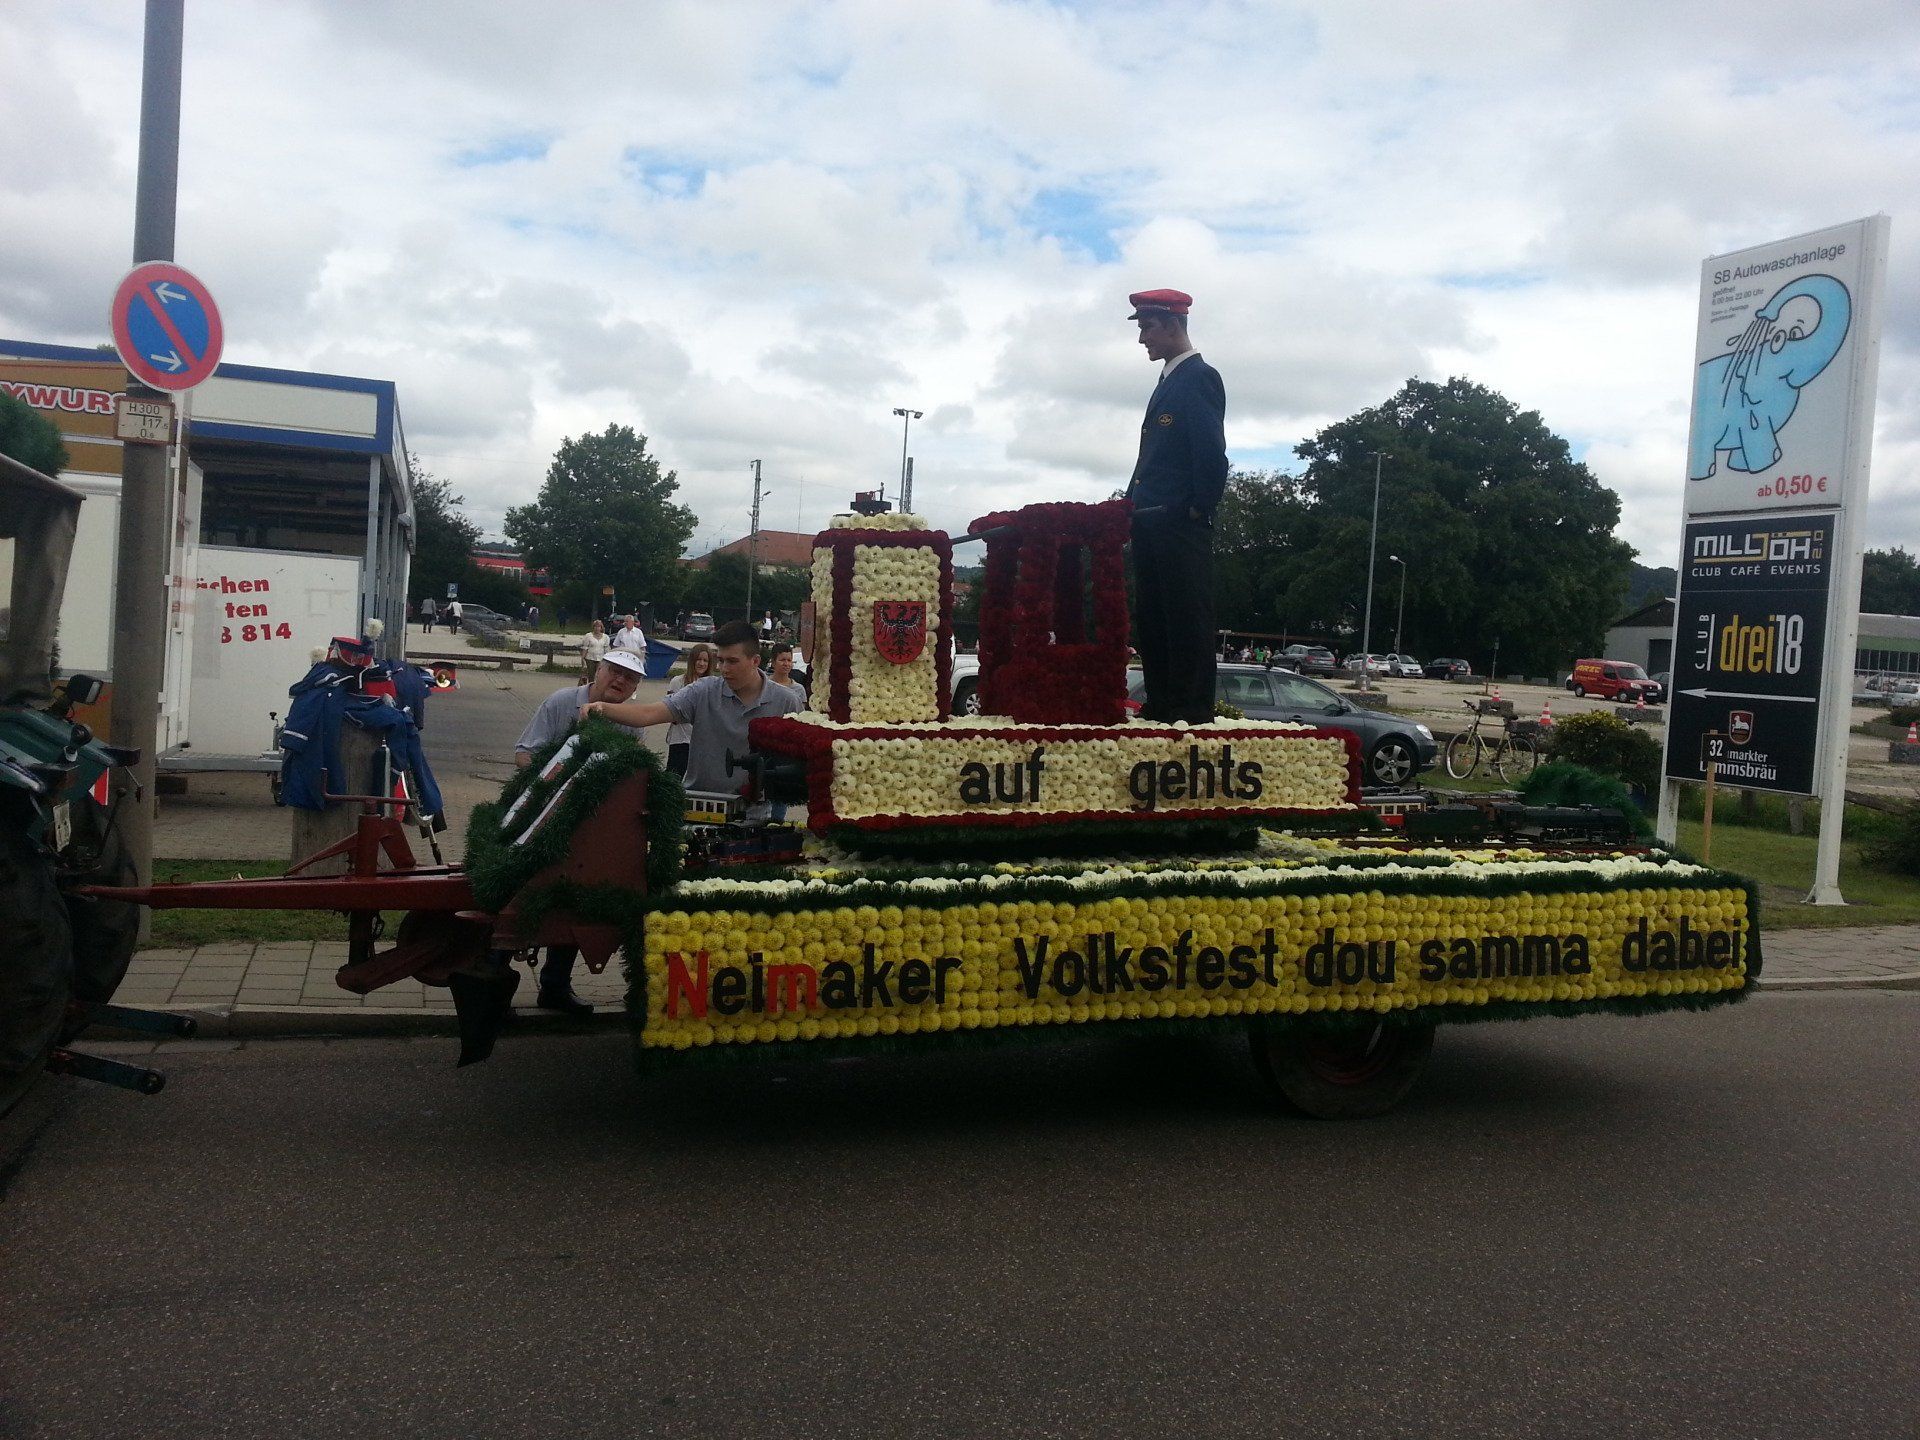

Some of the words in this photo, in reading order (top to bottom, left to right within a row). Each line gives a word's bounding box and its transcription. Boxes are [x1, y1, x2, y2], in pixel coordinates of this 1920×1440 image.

[1713, 269, 1731, 285] SB
[1733, 244, 1846, 279] Autowaschanlage
[1, 382, 126, 414] YWUR
[1757, 484, 1772, 497] ab
[1775, 474, 1813, 498] 0,50
[1817, 476, 1827, 493] €
[1691, 566, 1722, 577] CLUB
[1730, 564, 1761, 576] CAFÉ
[1770, 563, 1821, 575] EVENTS
[241, 622, 292, 642] 814
[1694, 614, 1710, 670] CLUB
[1709, 739, 1723, 757] 32
[1727, 750, 1769, 763] markter
[959, 746, 1045, 805] auf
[1129, 744, 1263, 812] gehts
[1699, 760, 1777, 781] Lmmsbräu
[667, 942, 963, 1020] Neimaker
[1013, 927, 1280, 1000] Volksfest
[1304, 927, 1396, 988] dou
[1419, 931, 1592, 983] samma
[1621, 914, 1742, 973] dabei
